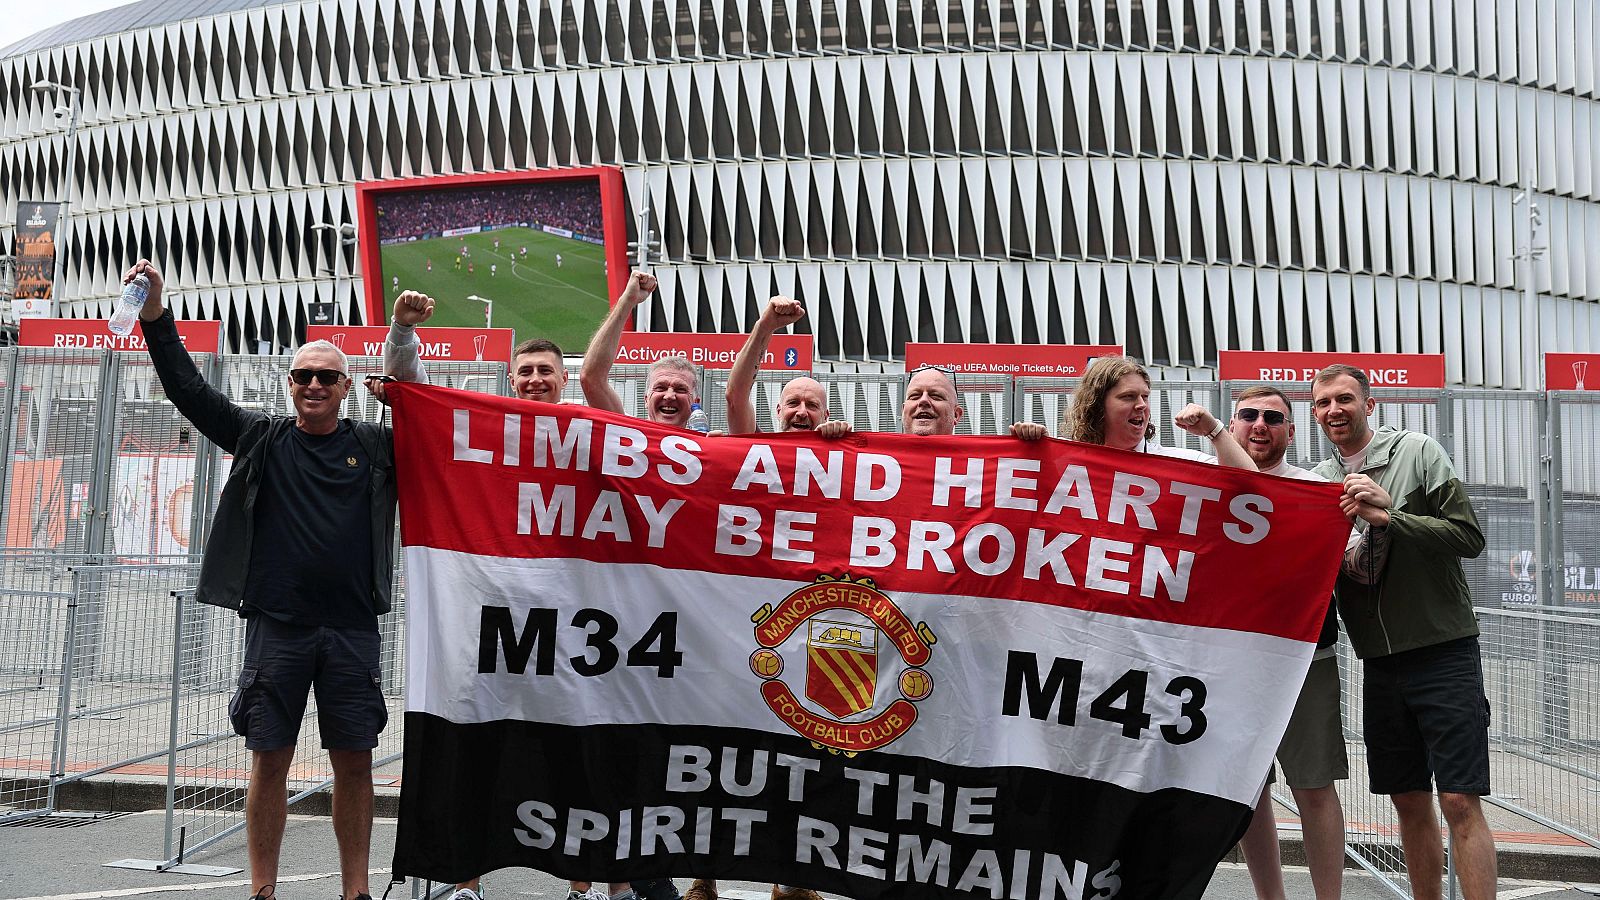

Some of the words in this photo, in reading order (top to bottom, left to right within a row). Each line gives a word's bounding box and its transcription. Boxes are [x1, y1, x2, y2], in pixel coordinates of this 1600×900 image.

[54, 334, 88, 349] RED
[93, 334, 187, 350] ENTRA
[363, 341, 452, 357] WOME
[616, 345, 687, 361] Activate
[692, 347, 774, 364] Blueth
[946, 363, 962, 371] the
[963, 363, 988, 372] UEFA
[989, 363, 1020, 372] Mobile
[1021, 363, 1054, 373] Tickets
[1055, 364, 1077, 374] App.
[1259, 368, 1297, 381] RED
[1302, 368, 1408, 385] ENCE
[453, 409, 703, 486] LIMBS
[731, 444, 901, 502] AND
[931, 457, 1274, 545] HEARTS
[516, 482, 686, 549] MAY
[714, 503, 818, 564] BE
[848, 515, 1195, 603] BROKEN
[763, 587, 872, 641] MANCHESTER
[872, 600, 920, 657] UNITED
[1501, 592, 1537, 602] EURO
[478, 605, 683, 678] M34
[773, 693, 855, 744] FOOTBALL
[859, 713, 904, 745] CLUB
[1001, 649, 1208, 745] M43
[665, 744, 821, 802] BUT
[844, 766, 998, 836] THE
[513, 800, 768, 860] SPIRIT
[796, 814, 1122, 900] REMAINS
